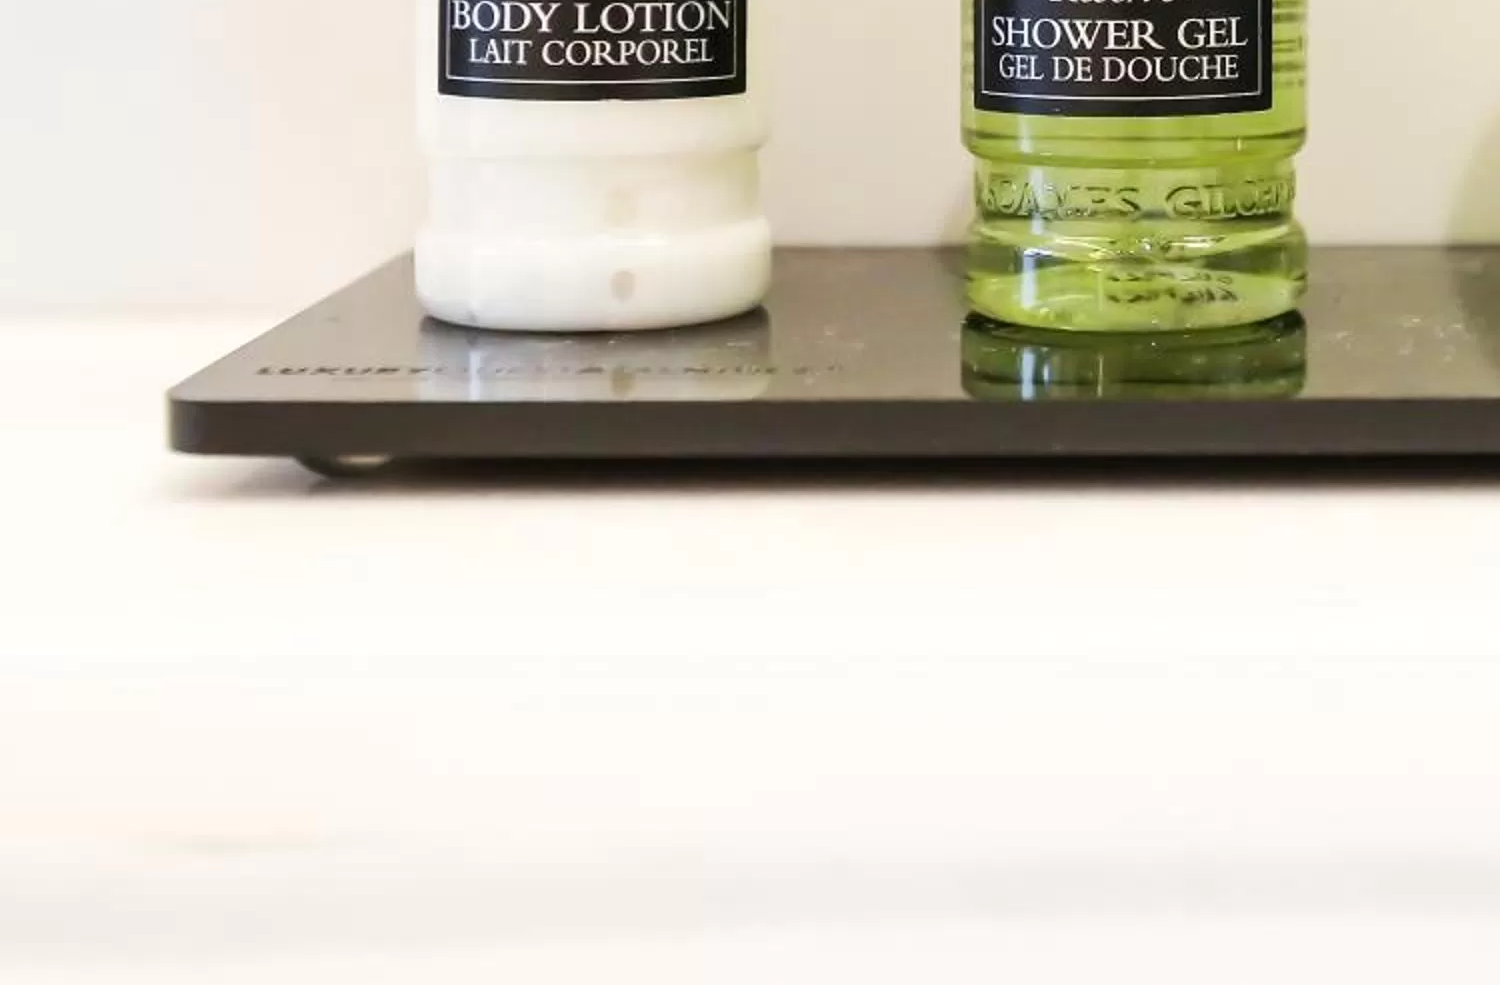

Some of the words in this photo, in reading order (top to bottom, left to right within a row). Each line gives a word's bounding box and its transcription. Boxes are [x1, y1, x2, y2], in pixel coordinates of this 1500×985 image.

[452, 0, 561, 32] BODY
[574, 0, 731, 33] LOTION
[991, 17, 1165, 50] SHOWER
[1177, 17, 1248, 49] GEL
[469, 39, 532, 65] LAIT
[541, 38, 713, 65] CORPOREL
[999, 54, 1044, 79] GEL
[1052, 56, 1093, 81] DE
[1102, 55, 1239, 82] DOUCHE
